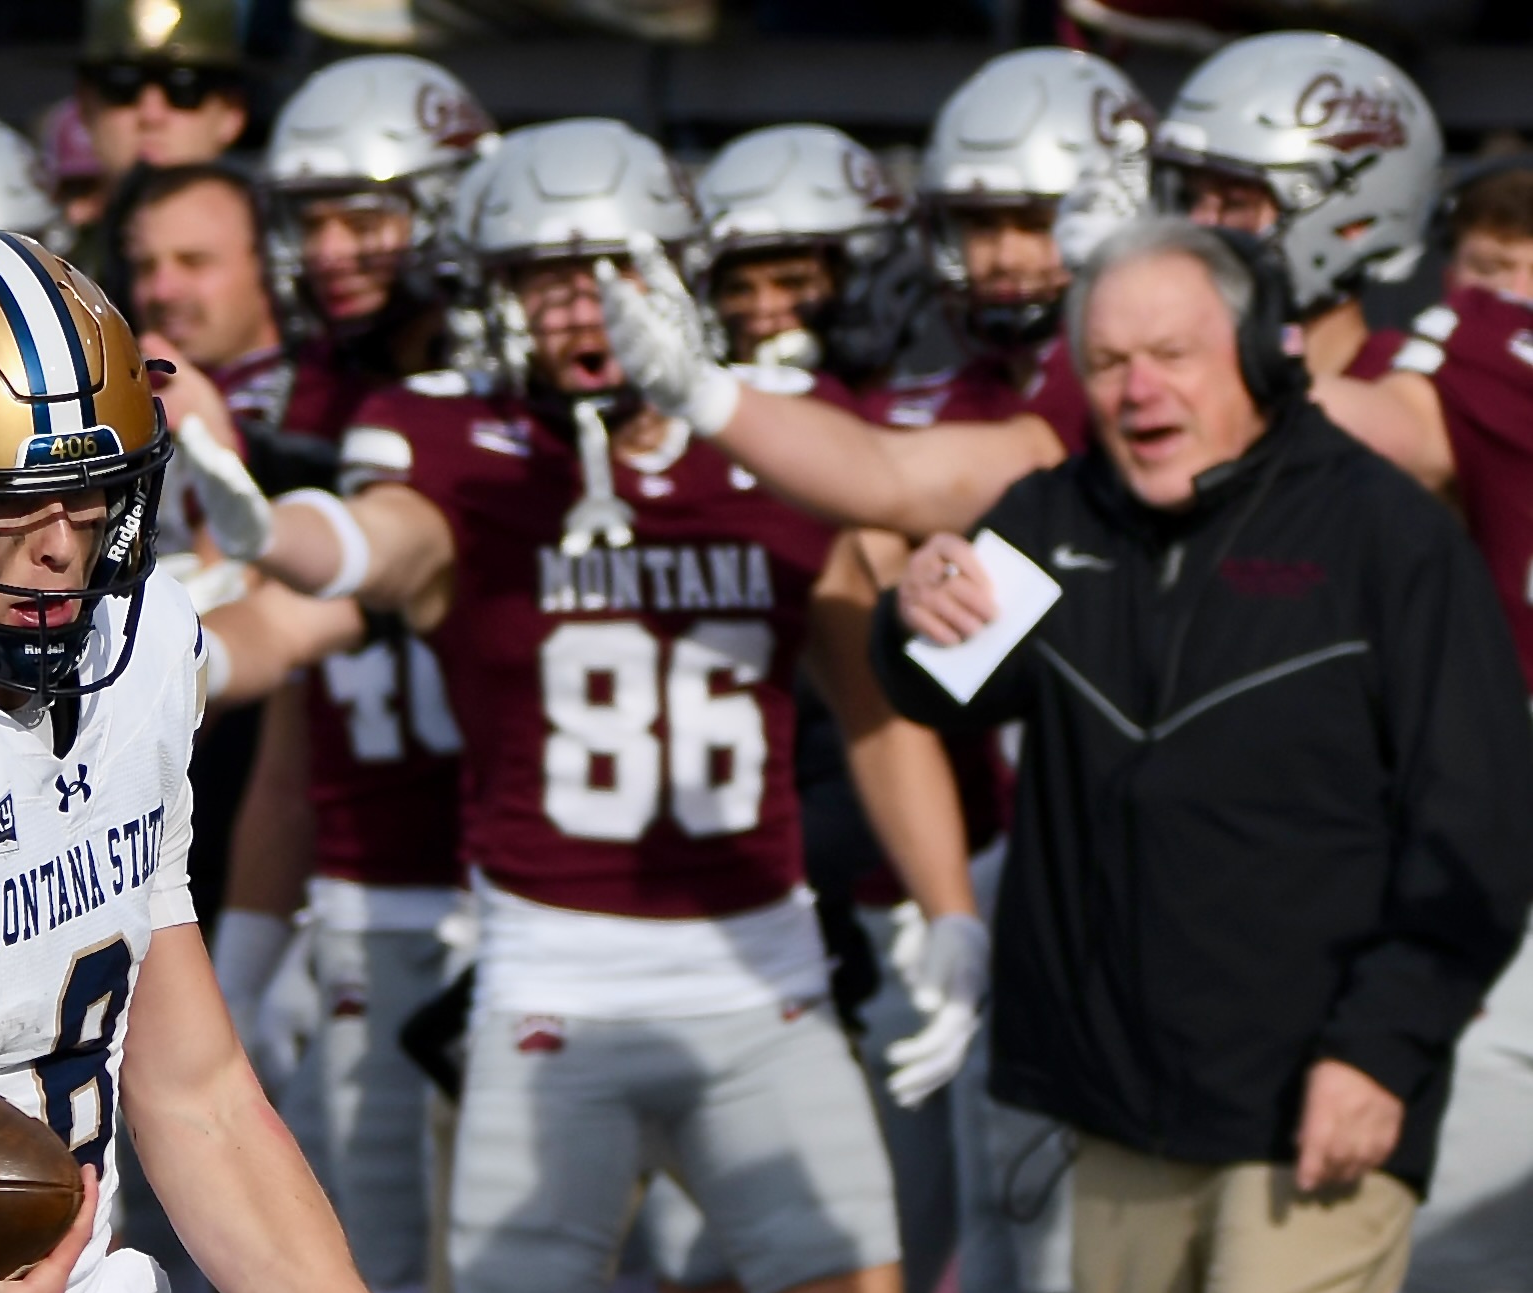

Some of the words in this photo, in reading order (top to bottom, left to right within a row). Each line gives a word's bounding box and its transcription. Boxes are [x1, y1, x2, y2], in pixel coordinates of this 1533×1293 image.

[49, 434, 98, 459] 406
[537, 545, 775, 612] MONTANA
[542, 621, 774, 842] 86
[107, 798, 165, 896] STAT
[30, 932, 135, 1183] 8
